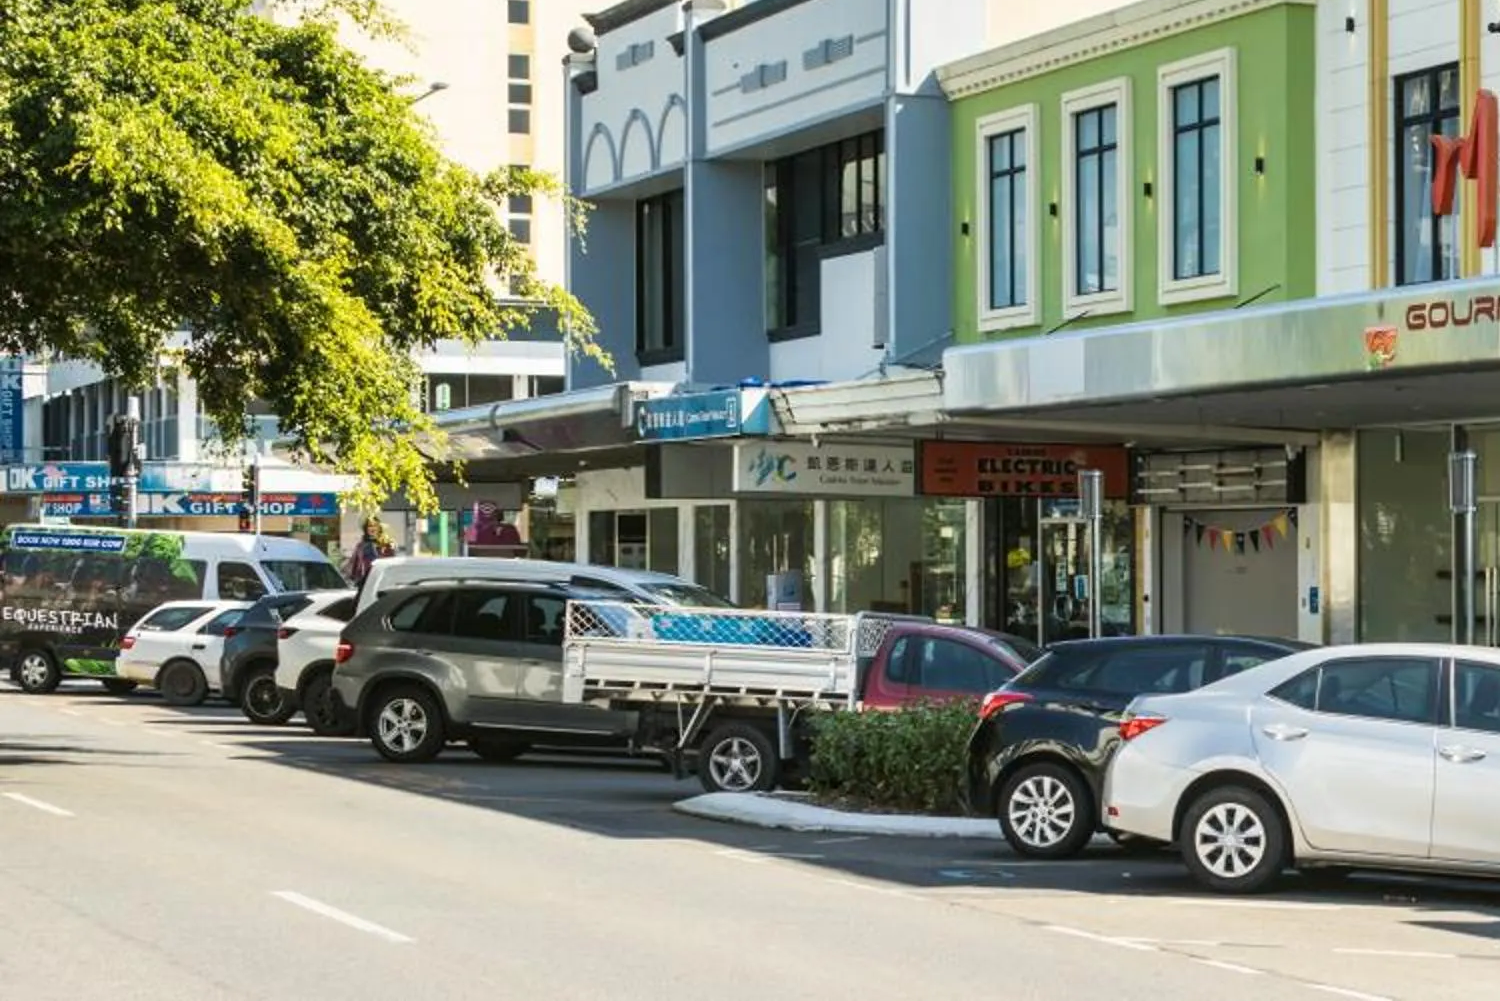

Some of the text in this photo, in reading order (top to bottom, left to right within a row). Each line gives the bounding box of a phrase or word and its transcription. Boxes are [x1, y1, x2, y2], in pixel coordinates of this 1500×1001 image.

[977, 458, 1078, 474] ELECTRIC
[43, 476, 80, 488] GIFT
[977, 480, 1076, 493] BIKES
[189, 502, 235, 514] GIFT
[3, 606, 119, 630] EQUESTRIAN
[27, 623, 83, 634] EXPERIENCE
